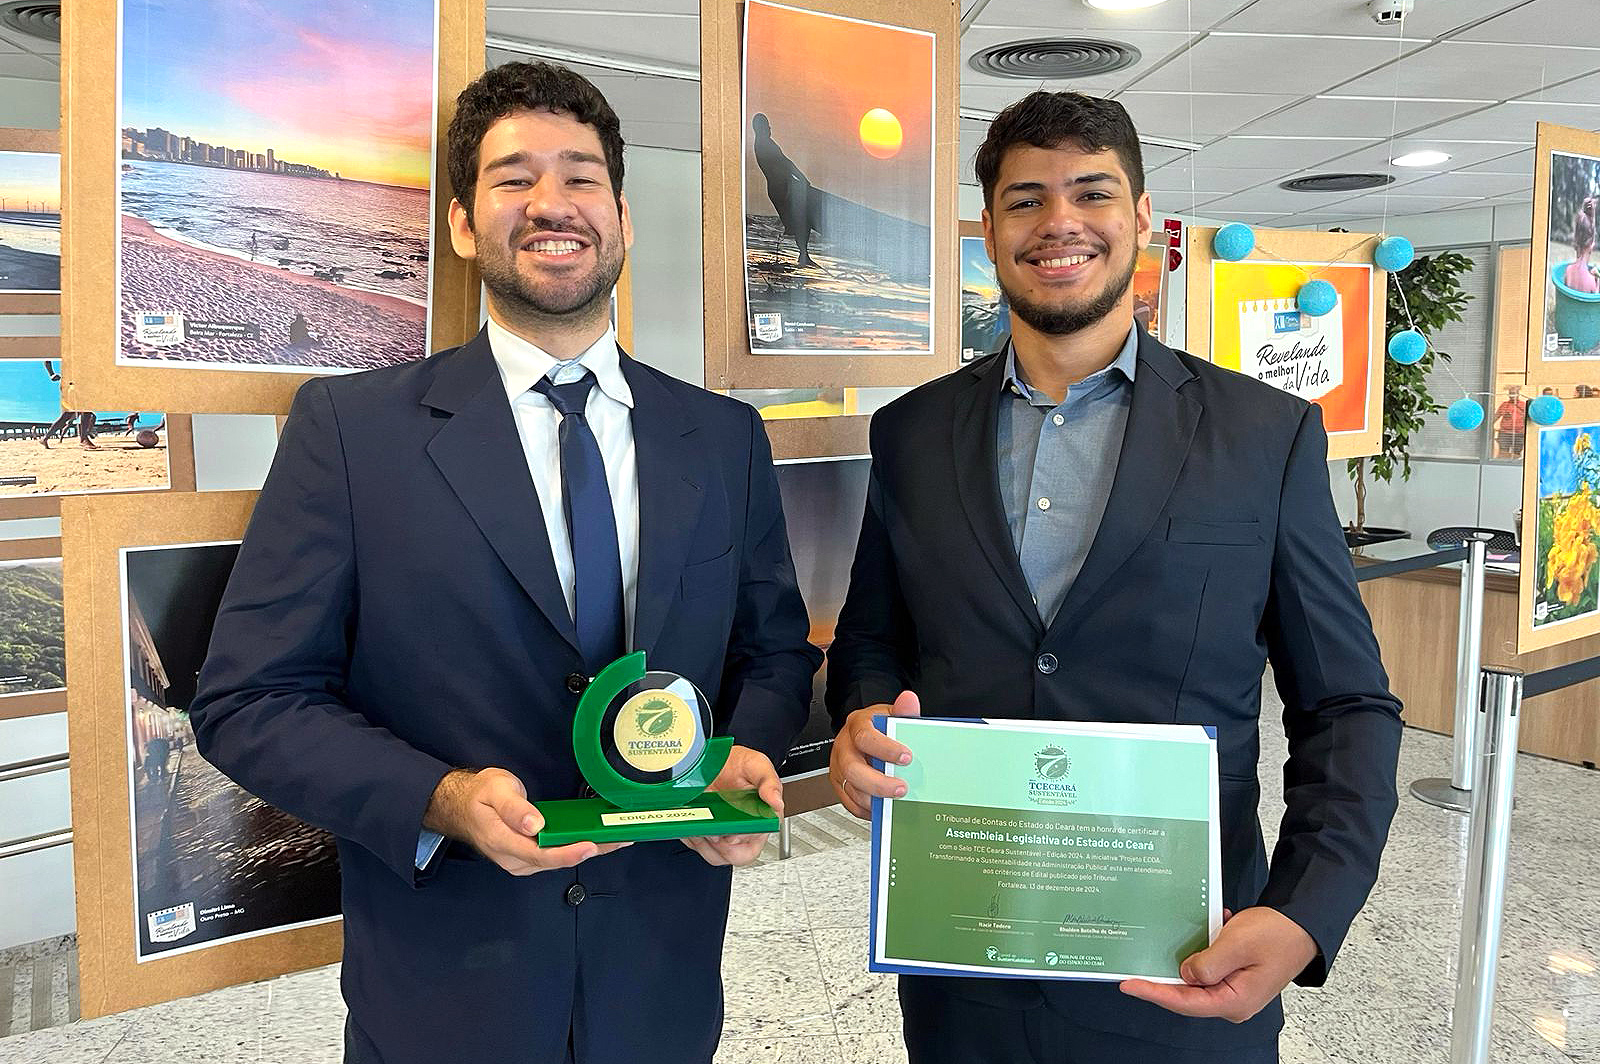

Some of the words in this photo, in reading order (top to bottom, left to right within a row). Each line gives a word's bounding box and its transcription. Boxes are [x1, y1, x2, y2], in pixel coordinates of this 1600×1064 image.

[1256, 335, 1328, 366] Revelando
[1258, 372, 1264, 380] o
[1265, 365, 1294, 379] melhor
[628, 748, 683, 756] SUSTENTÁVEL
[1028, 790, 1078, 798] SUSTENTÁVEL
[936, 814, 940, 822] O
[943, 814, 970, 824] Tribunal
[972, 816, 980, 824] de
[982, 818, 1007, 827] Contas
[1008, 820, 1018, 828] do
[1018, 820, 1044, 829] Estado
[1044, 822, 1054, 830] do
[1076, 824, 1090, 832] tem
[1096, 826, 1118, 834] honra
[1128, 827, 1160, 836] certificar
[946, 828, 1004, 842] Assembleia
[1006, 832, 1060, 846] Legislativa
[1062, 836, 1074, 846] do
[1076, 836, 1110, 848] Estado
[1112, 839, 1124, 849] do
[1126, 840, 1154, 850] Ceará
[930, 852, 974, 863] Transformando
[980, 856, 1032, 867] Sustentabilidade
[1042, 861, 1084, 870] Administração
[1049, 872, 1078, 880] publicado
